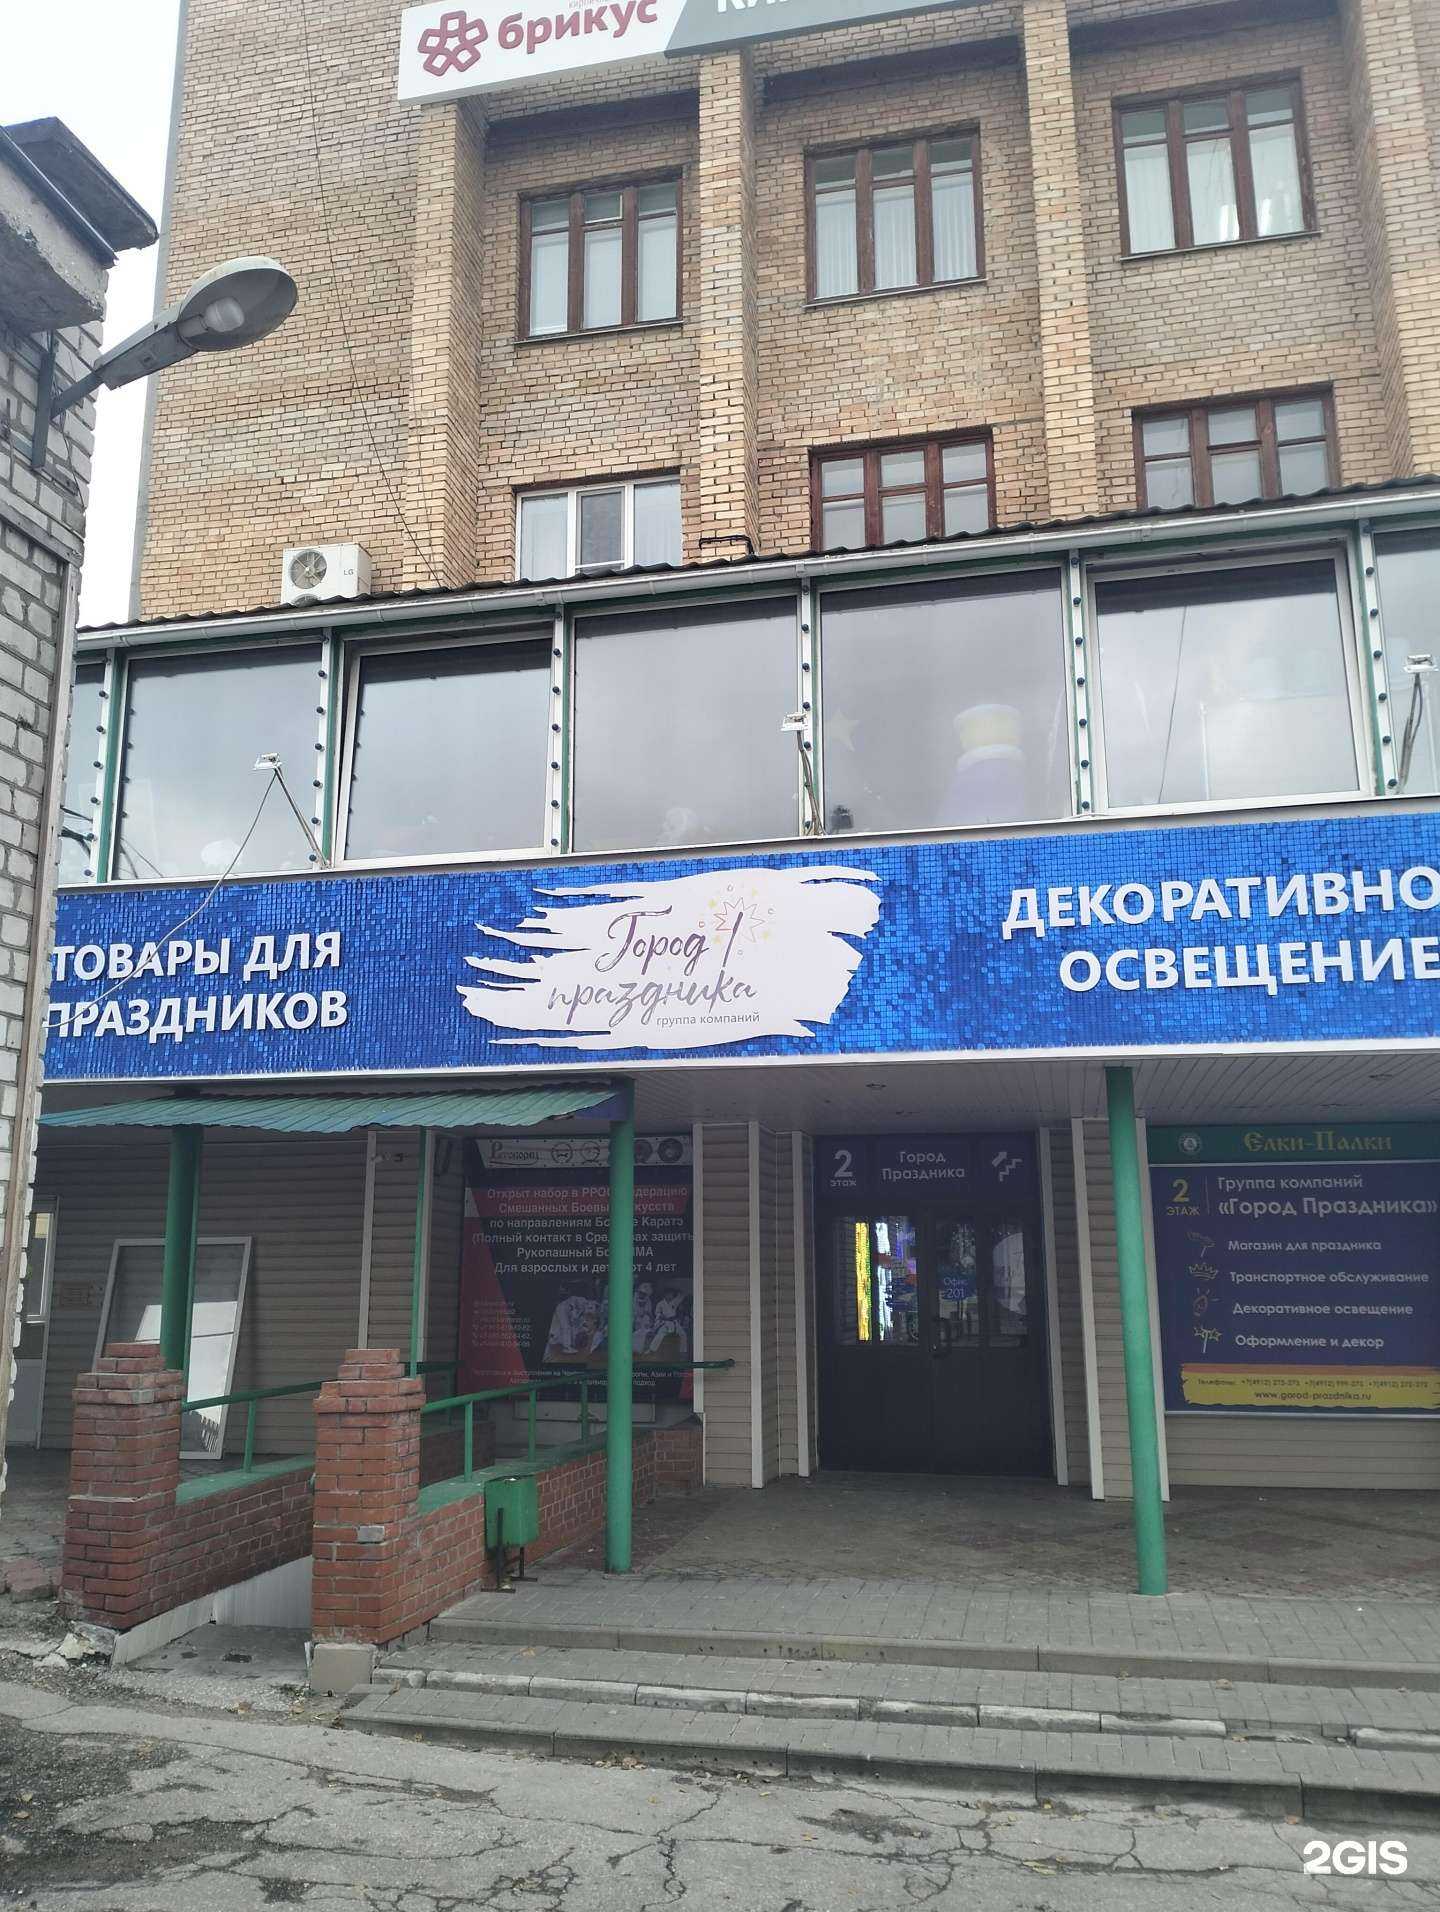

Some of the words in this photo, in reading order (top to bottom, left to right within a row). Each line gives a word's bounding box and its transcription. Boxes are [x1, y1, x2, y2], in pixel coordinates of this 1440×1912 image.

[498, 0, 657, 54] брикус
[343, 568, 354, 576] LG
[595, 905, 709, 977] Город
[51, 937, 231, 982] ТОВАРЫ
[243, 931, 342, 982] ДЛЯ
[1059, 936, 1440, 996] ОСВЕЩЕНИЕ
[548, 968, 758, 1027] праздника
[46, 990, 348, 1044] ПРАЗДНИКОВ
[656, 1014, 697, 1027] группа
[700, 1011, 761, 1024] компаний
[834, 1150, 853, 1178] 2
[899, 1151, 947, 1166] Город
[882, 1167, 966, 1182] Праздника
[1172, 1179, 1190, 1203] 2
[1217, 1177, 1276, 1193] Группа
[1280, 1174, 1364, 1189] компаний
[487, 1188, 529, 1200] Открыт
[534, 1188, 568, 1199] набор
[571, 1190, 578, 1198] в
[635, 1187, 688, 1199] дерацию
[499, 1203, 568, 1213] Смешанных
[571, 1202, 609, 1213] Боевы
[1218, 1199, 1297, 1218] «Город
[1302, 1197, 1438, 1218] Праздника»
[490, 1219, 504, 1228] по
[507, 1218, 592, 1229] направлениям
[641, 1216, 684, 1229] Каратэ
[526, 1233, 572, 1243] контакт
[576, 1234, 583, 1242] в
[517, 1247, 592, 1260] Рукопашный
[1228, 1240, 1282, 1252] Магазин
[1286, 1241, 1308, 1252] для
[1312, 1241, 1382, 1252] праздника
[495, 1263, 517, 1274] Для
[521, 1264, 578, 1275] взрослых
[581, 1265, 589, 1273] и
[645, 1262, 653, 1272] 4
[655, 1263, 678, 1273] лет
[1230, 1271, 1326, 1284] Транспортное
[1329, 1271, 1429, 1284] обслуживание
[1233, 1304, 1331, 1315] Декоративное
[1335, 1304, 1414, 1316] освещение
[1235, 1335, 1327, 1349] Оформление
[1331, 1339, 1339, 1347] и
[1342, 1338, 1385, 1350] декор
